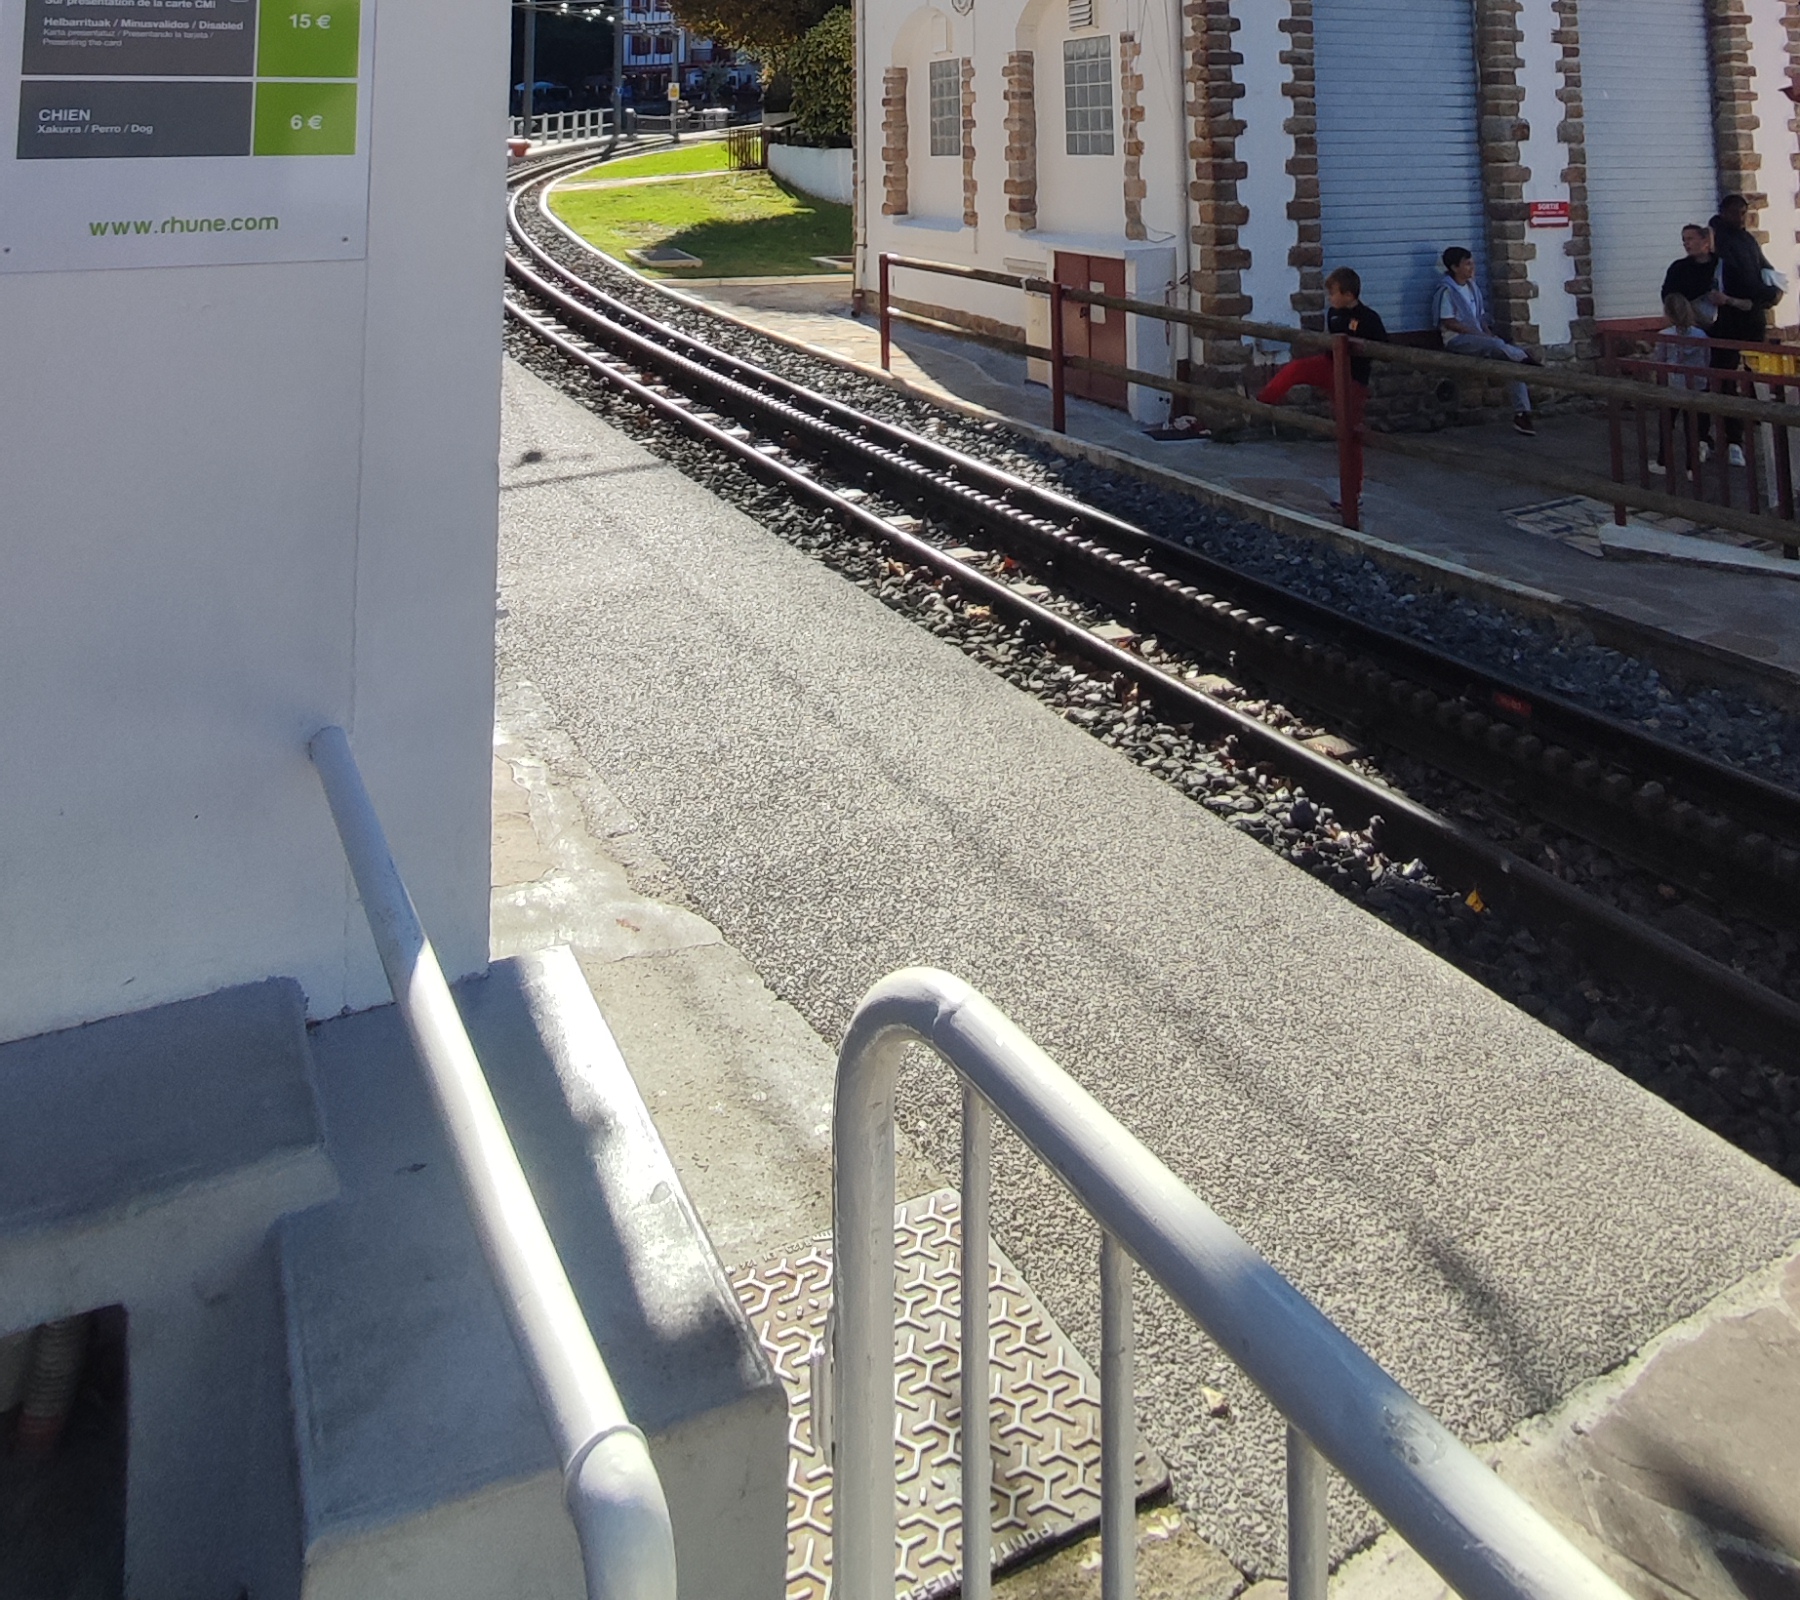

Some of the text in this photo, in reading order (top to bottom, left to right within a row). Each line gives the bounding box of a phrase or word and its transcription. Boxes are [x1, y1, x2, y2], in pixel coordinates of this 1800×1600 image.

[153, 0, 163, 7] la
[165, 0, 192, 8] carte
[195, 0, 216, 9] CMI
[199, 21, 244, 30] Disabled
[289, 14, 331, 29] 15 €
[38, 108, 91, 121] CHIEN
[290, 114, 323, 130] 6 €
[37, 124, 81, 134] Xakurra
[91, 124, 121, 133] Perro
[131, 124, 153, 135] Dog
[89, 215, 279, 236] www.rhune.com
[1001, 1521, 1053, 1559] PONT
